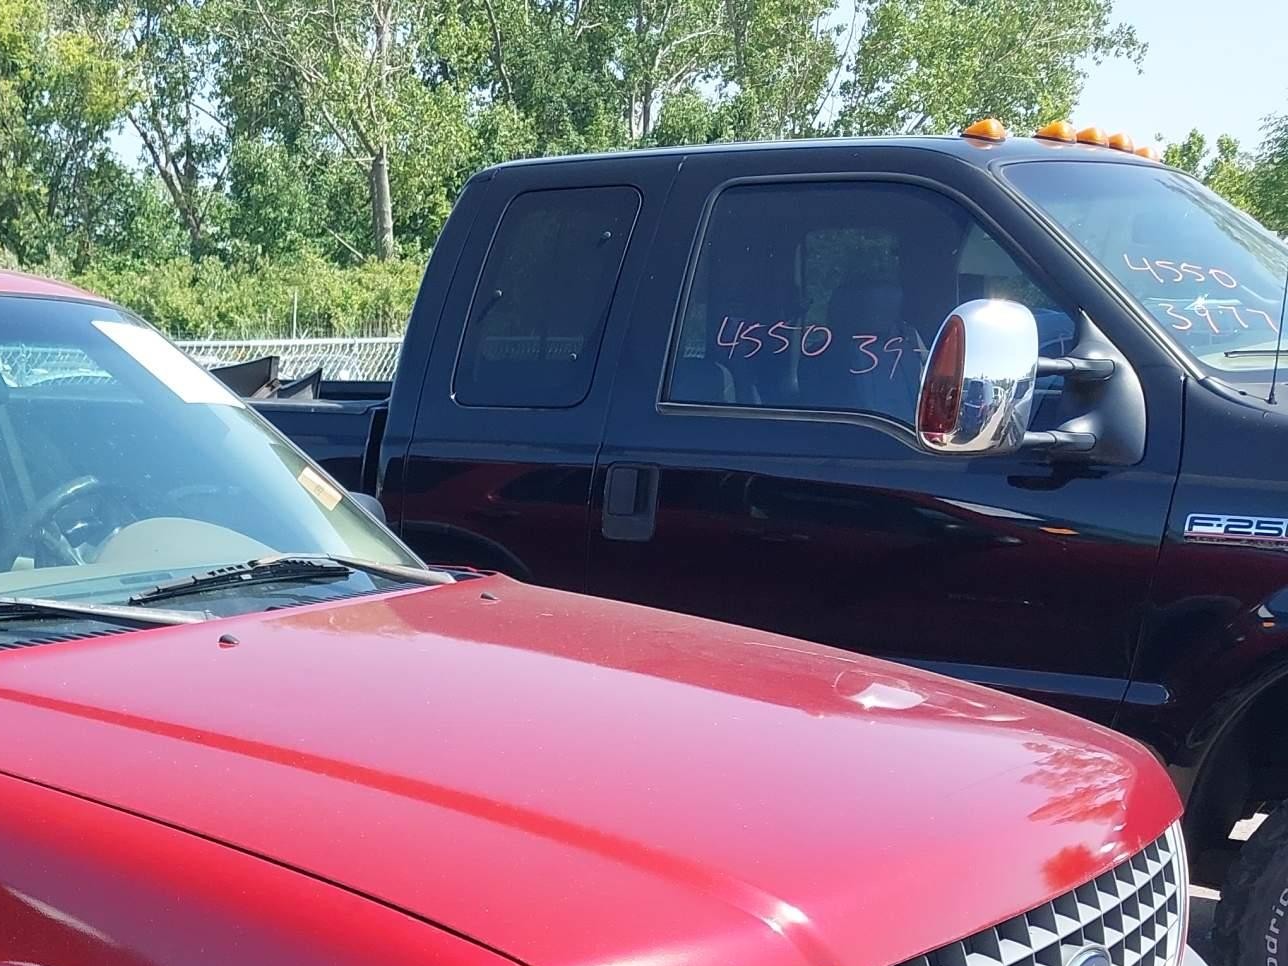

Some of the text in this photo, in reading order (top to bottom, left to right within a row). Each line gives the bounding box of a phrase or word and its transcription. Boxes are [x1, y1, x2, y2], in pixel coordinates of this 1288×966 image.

[1123, 253, 1237, 288] 4550
[1158, 303, 1278, 333] 3977
[717, 316, 929, 380] 4550 39
[1188, 516, 1288, 537] F-25
